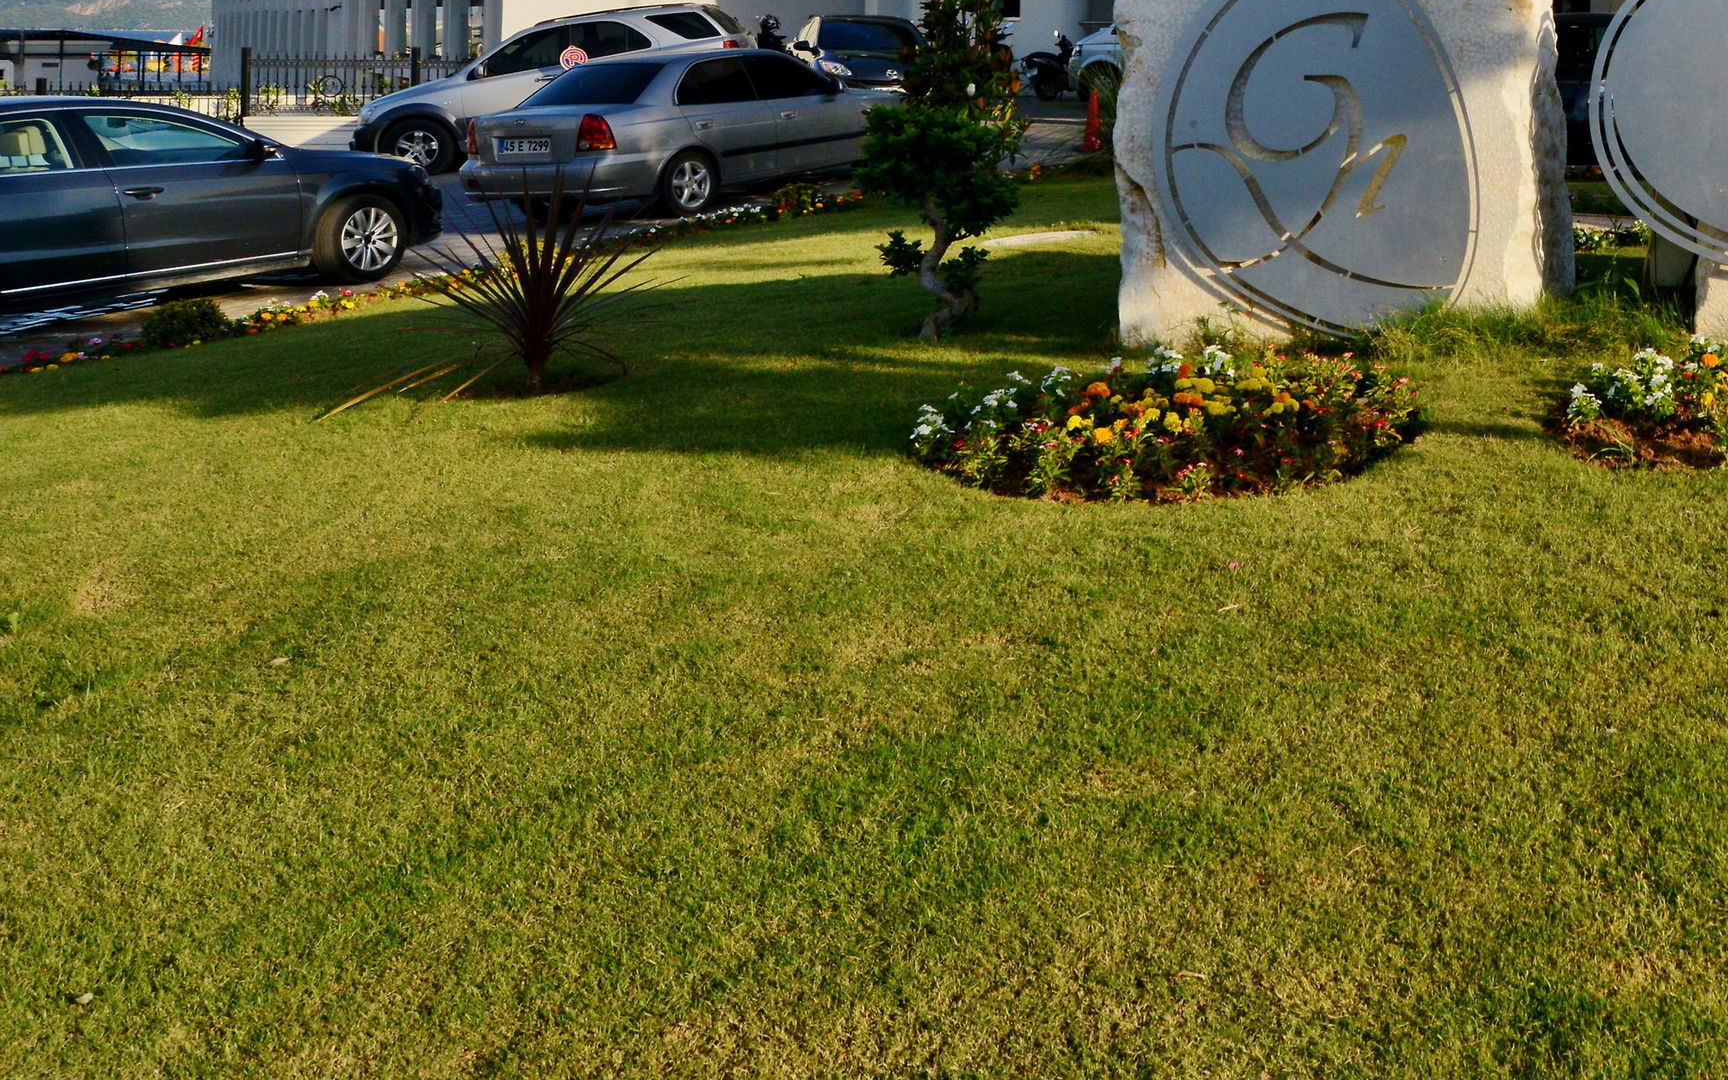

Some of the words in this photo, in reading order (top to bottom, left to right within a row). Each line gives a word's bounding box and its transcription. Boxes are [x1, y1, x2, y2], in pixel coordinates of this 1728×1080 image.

[503, 141, 515, 152] 45
[518, 141, 524, 152] E
[527, 140, 550, 151] 7299
